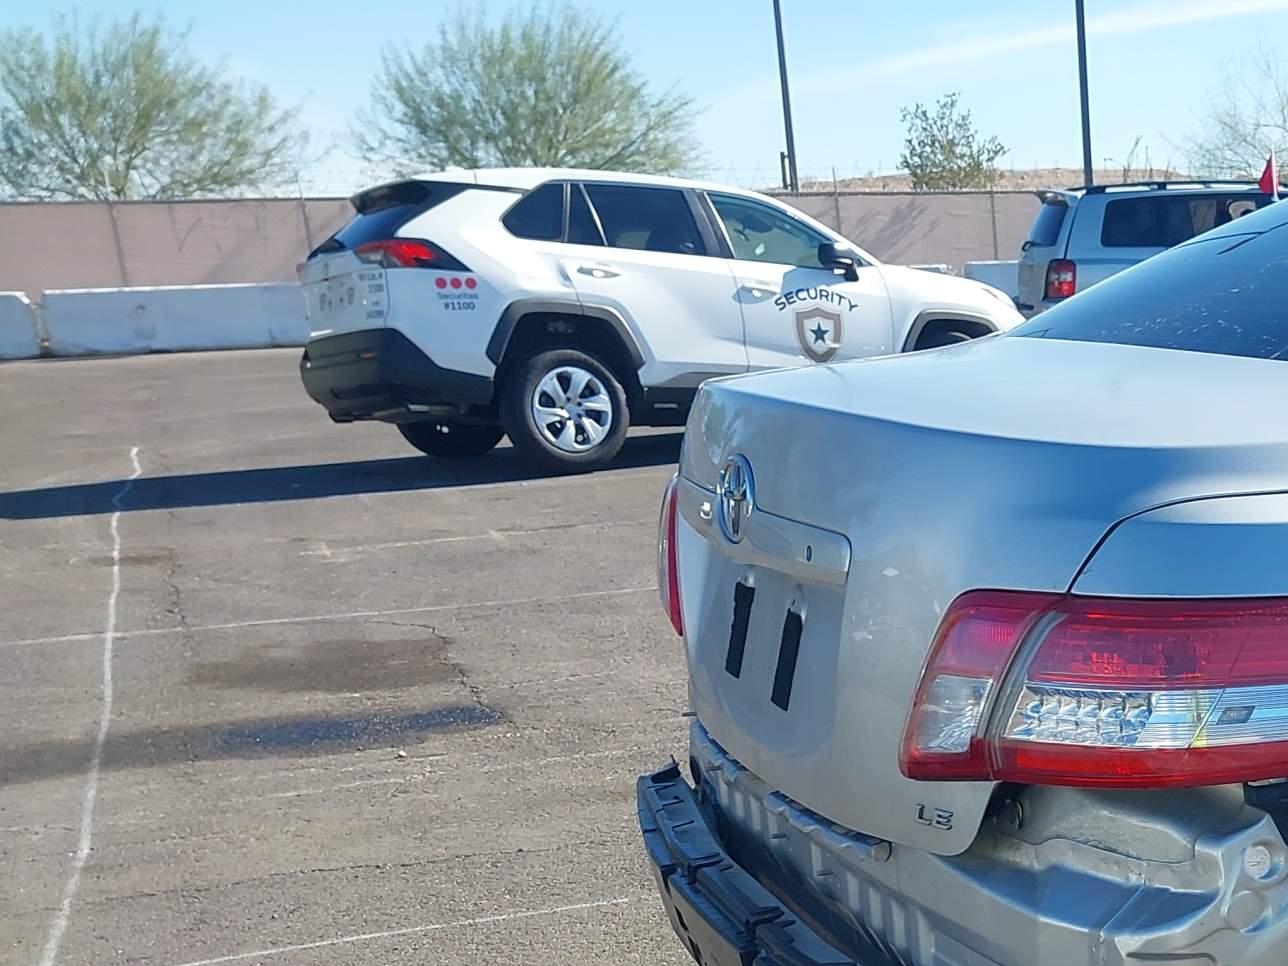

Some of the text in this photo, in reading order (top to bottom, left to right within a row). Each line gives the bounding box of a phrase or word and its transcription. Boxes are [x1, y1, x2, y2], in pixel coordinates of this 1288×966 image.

[444, 301, 477, 311] #1100
[774, 287, 859, 312] SECURITY
[915, 802, 954, 831] LE
